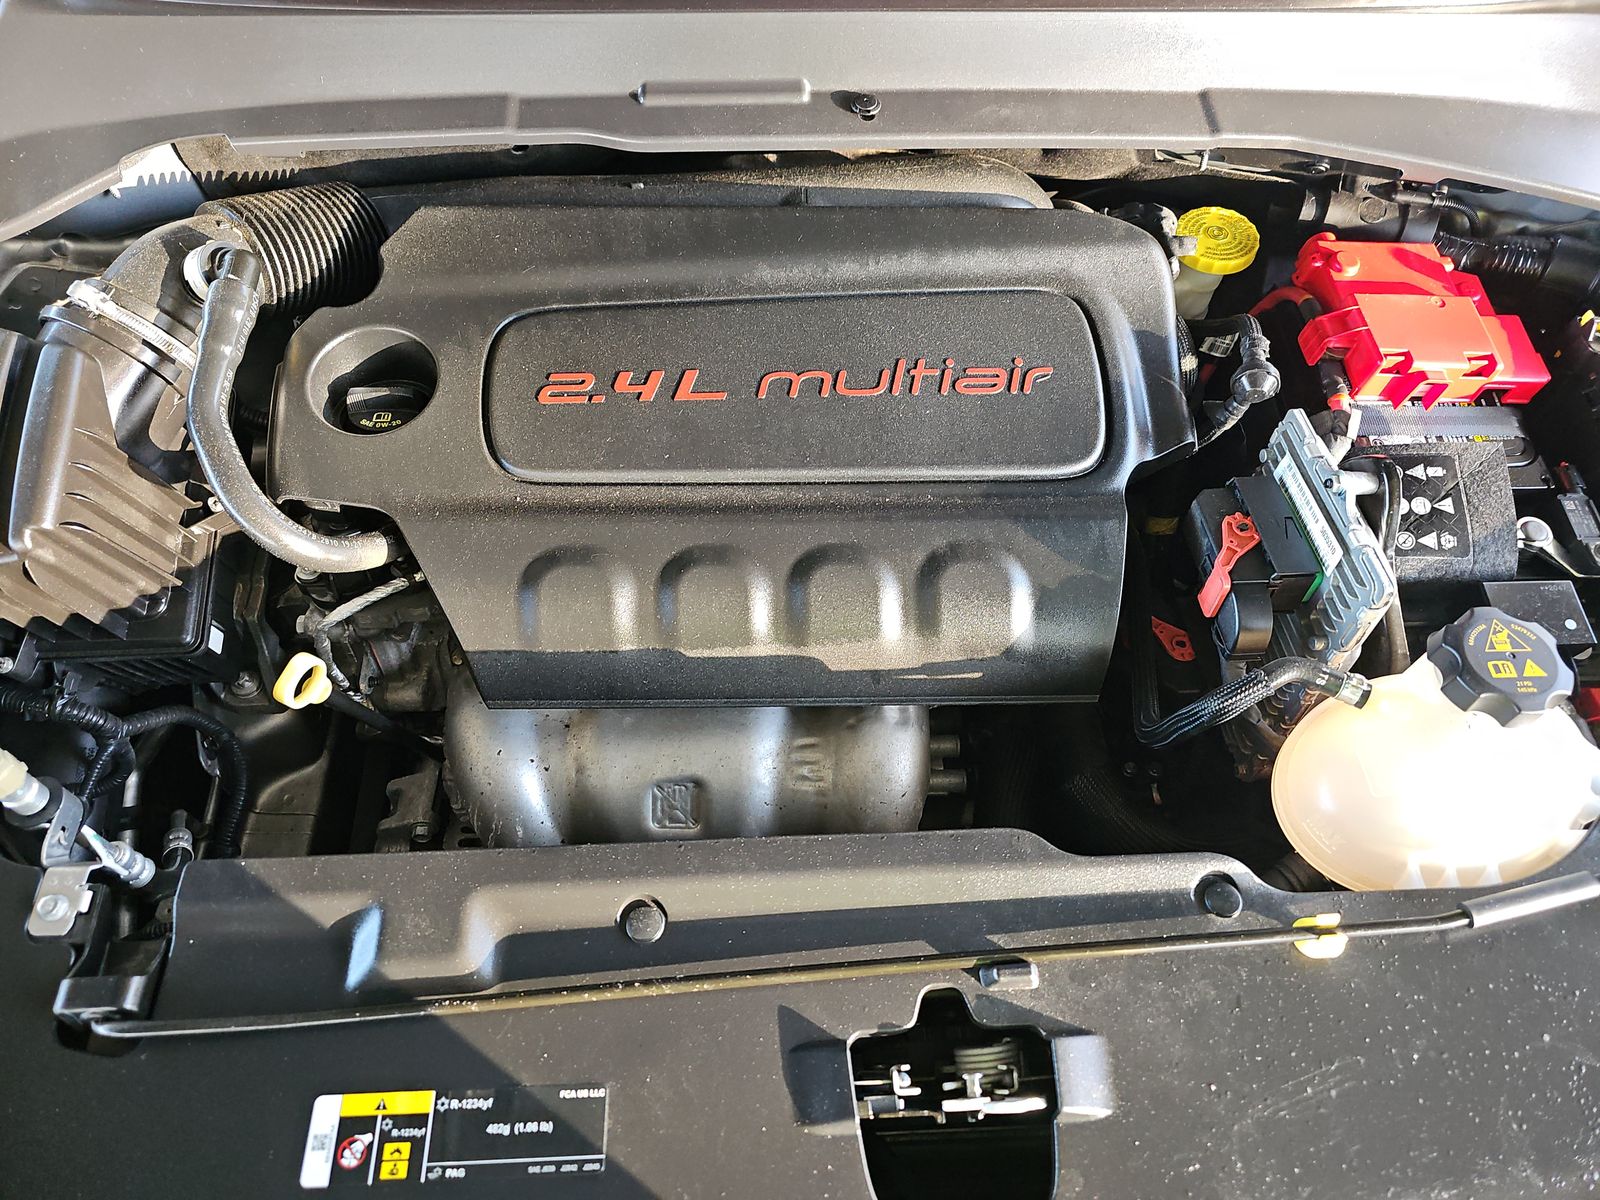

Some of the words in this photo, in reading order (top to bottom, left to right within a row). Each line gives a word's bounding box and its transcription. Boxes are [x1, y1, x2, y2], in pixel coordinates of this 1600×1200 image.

[757, 357, 1055, 399] multiair
[360, 418, 375, 428] SAE
[376, 419, 402, 428] 0W-20
[559, 1089, 577, 1099] FCA
[589, 1088, 606, 1097] LLC
[449, 1097, 494, 1111] R-1234yf
